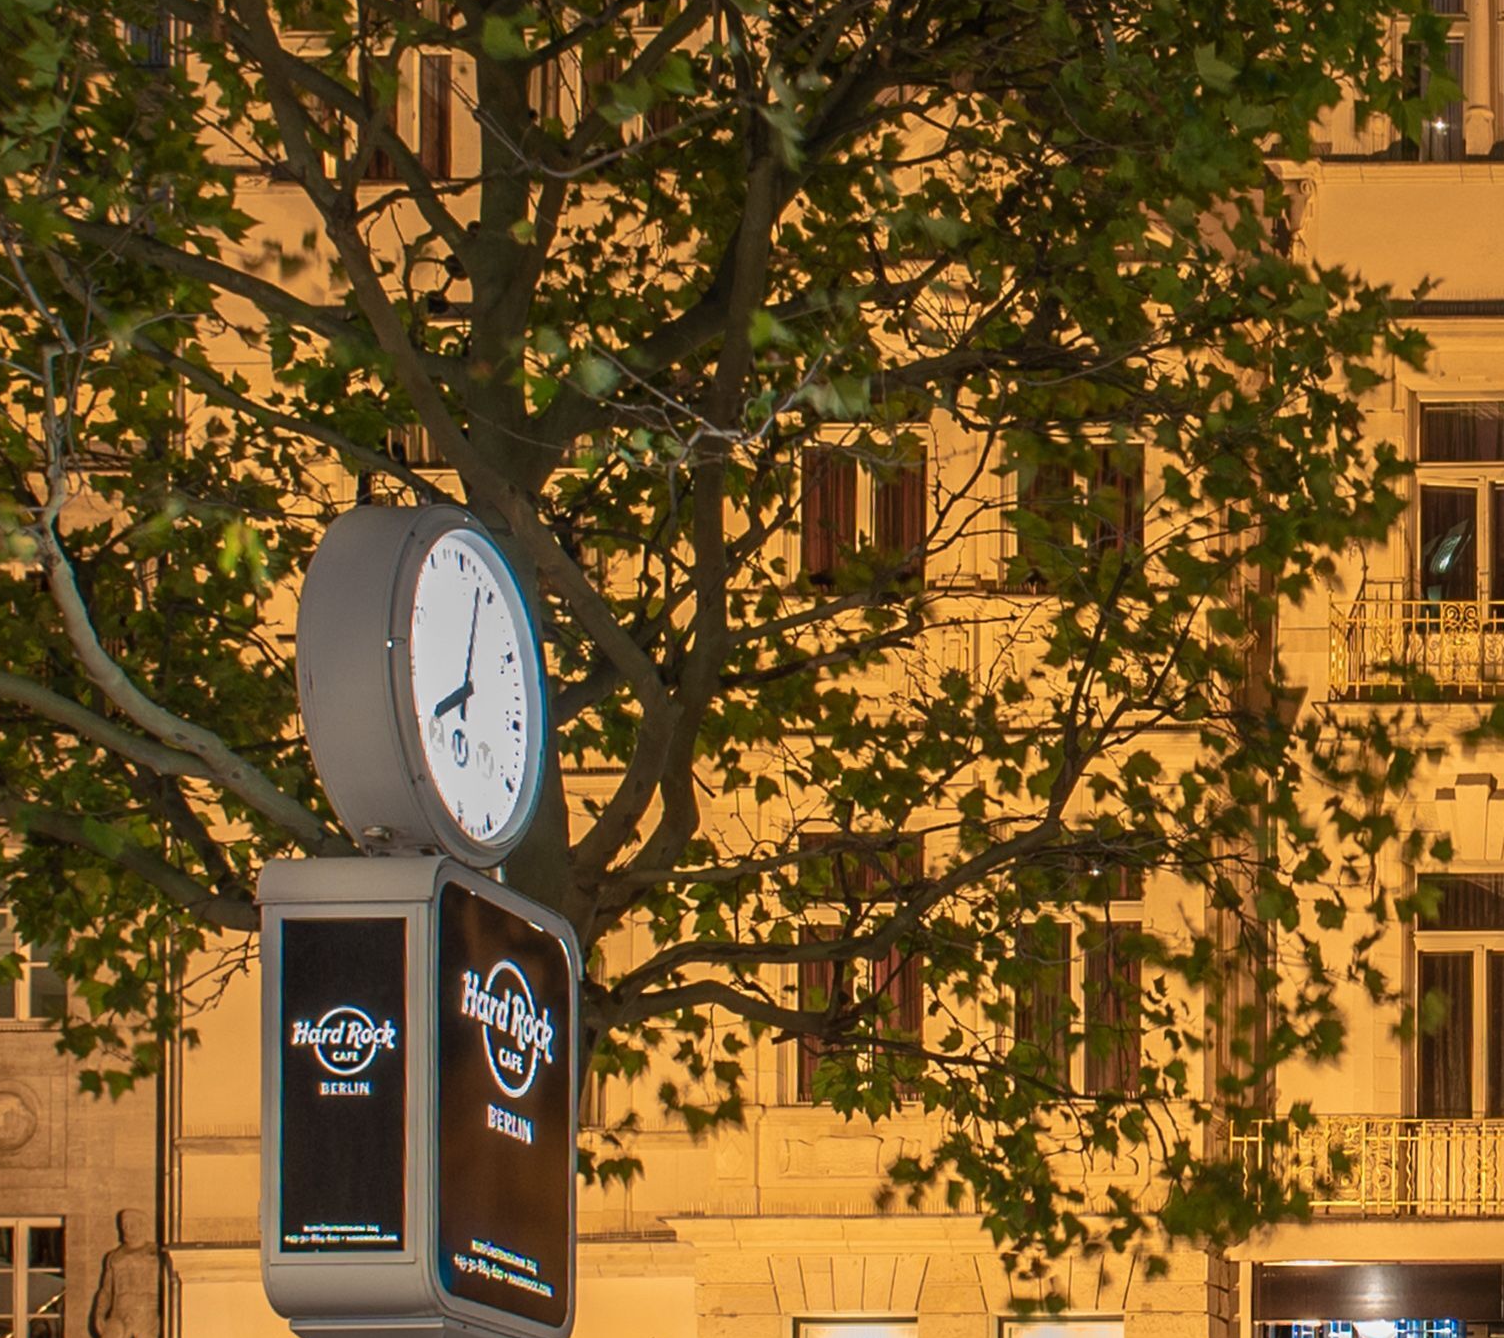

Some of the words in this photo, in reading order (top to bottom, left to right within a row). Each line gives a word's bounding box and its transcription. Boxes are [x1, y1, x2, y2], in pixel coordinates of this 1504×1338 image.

[461, 970, 512, 1033] Hard
[509, 993, 555, 1065] Rock
[291, 1020, 346, 1046] Hard
[346, 1020, 397, 1050] Rock
[332, 1050, 361, 1062] CAFE
[498, 1047, 525, 1076] CAFE
[319, 1081, 372, 1096] BERLIN
[487, 1103, 534, 1145] BERLIN
